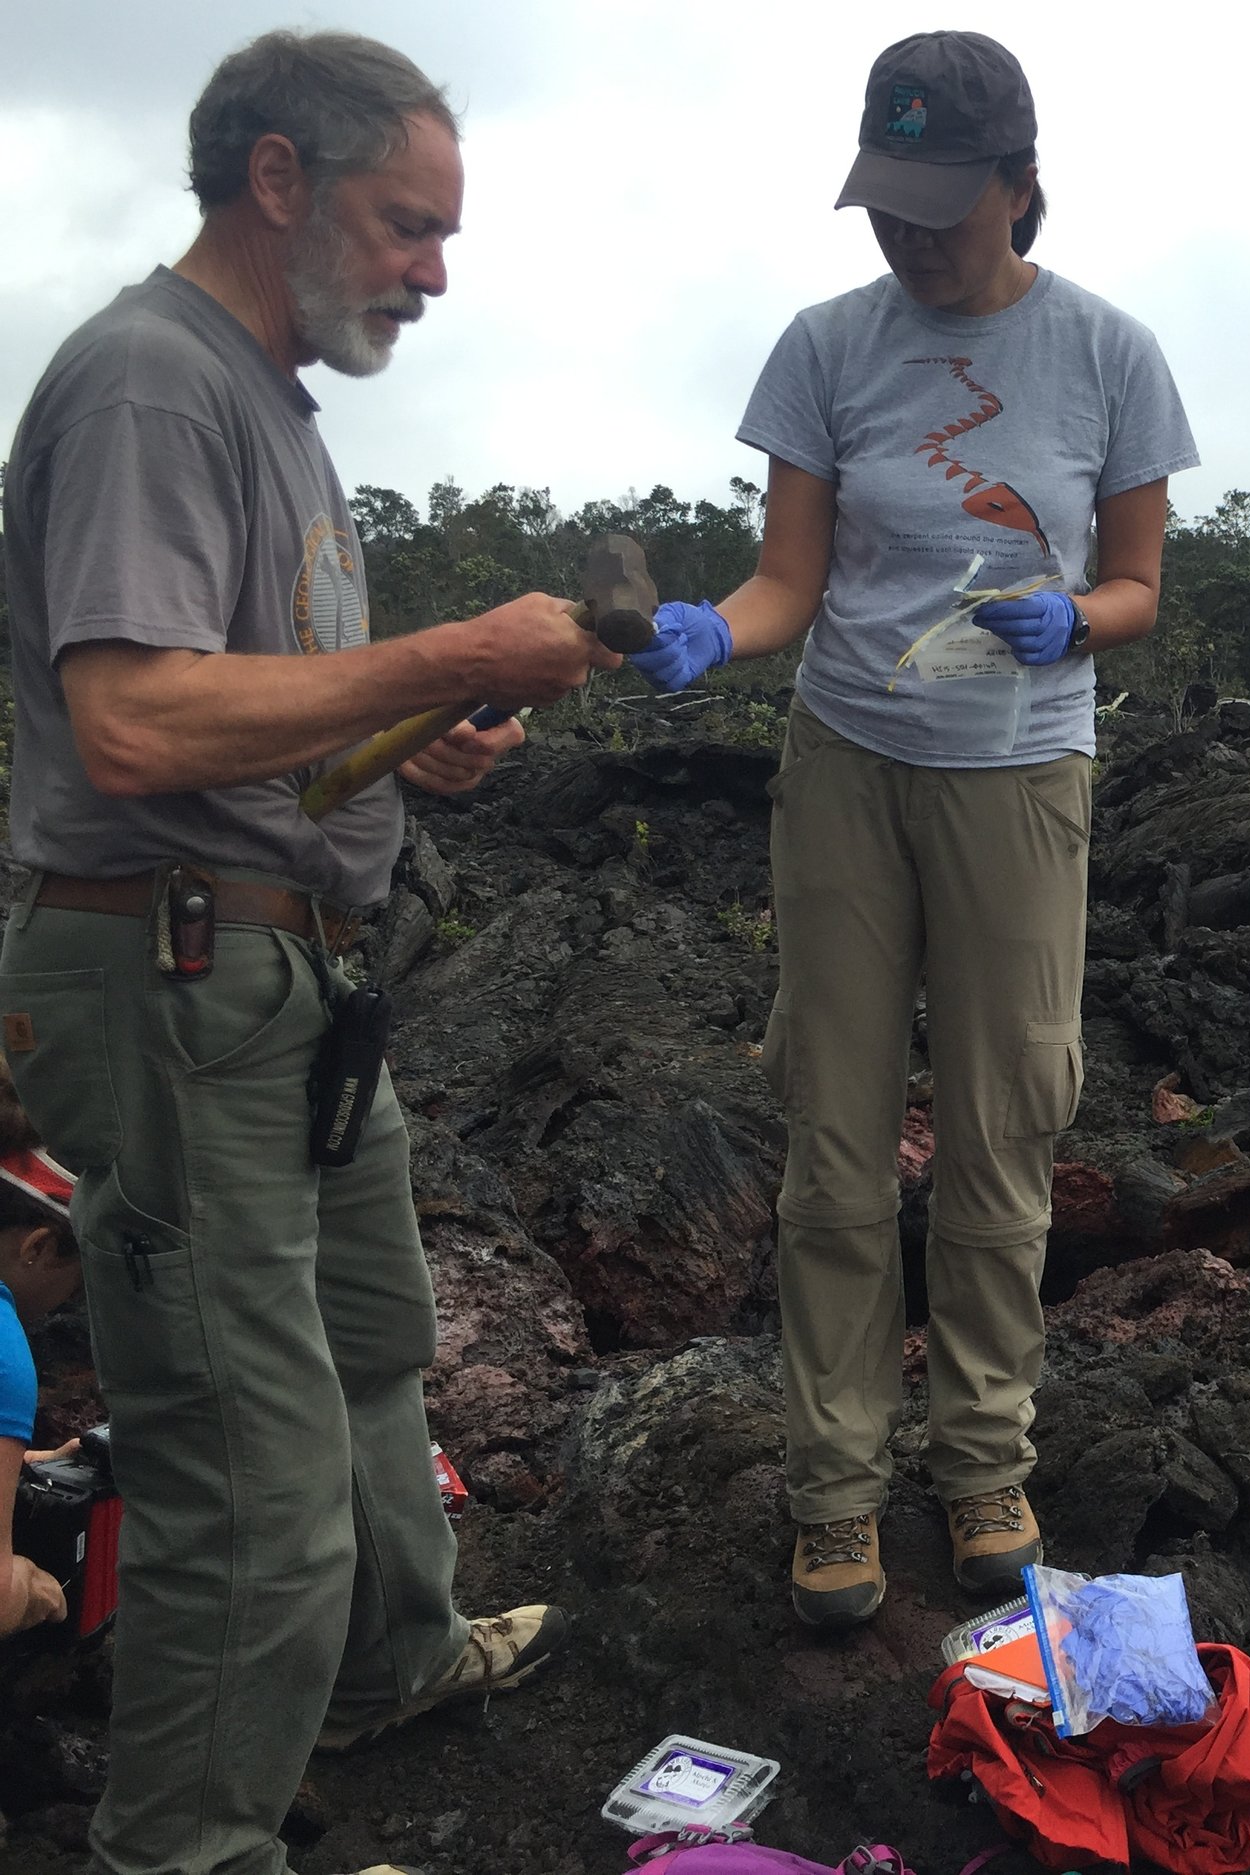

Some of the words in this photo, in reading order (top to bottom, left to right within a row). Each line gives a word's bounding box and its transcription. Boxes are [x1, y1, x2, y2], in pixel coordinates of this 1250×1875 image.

[903, 533, 929, 541] serpent
[954, 534, 981, 542] around
[982, 535, 995, 543] the
[996, 537, 1029, 546] mountain
